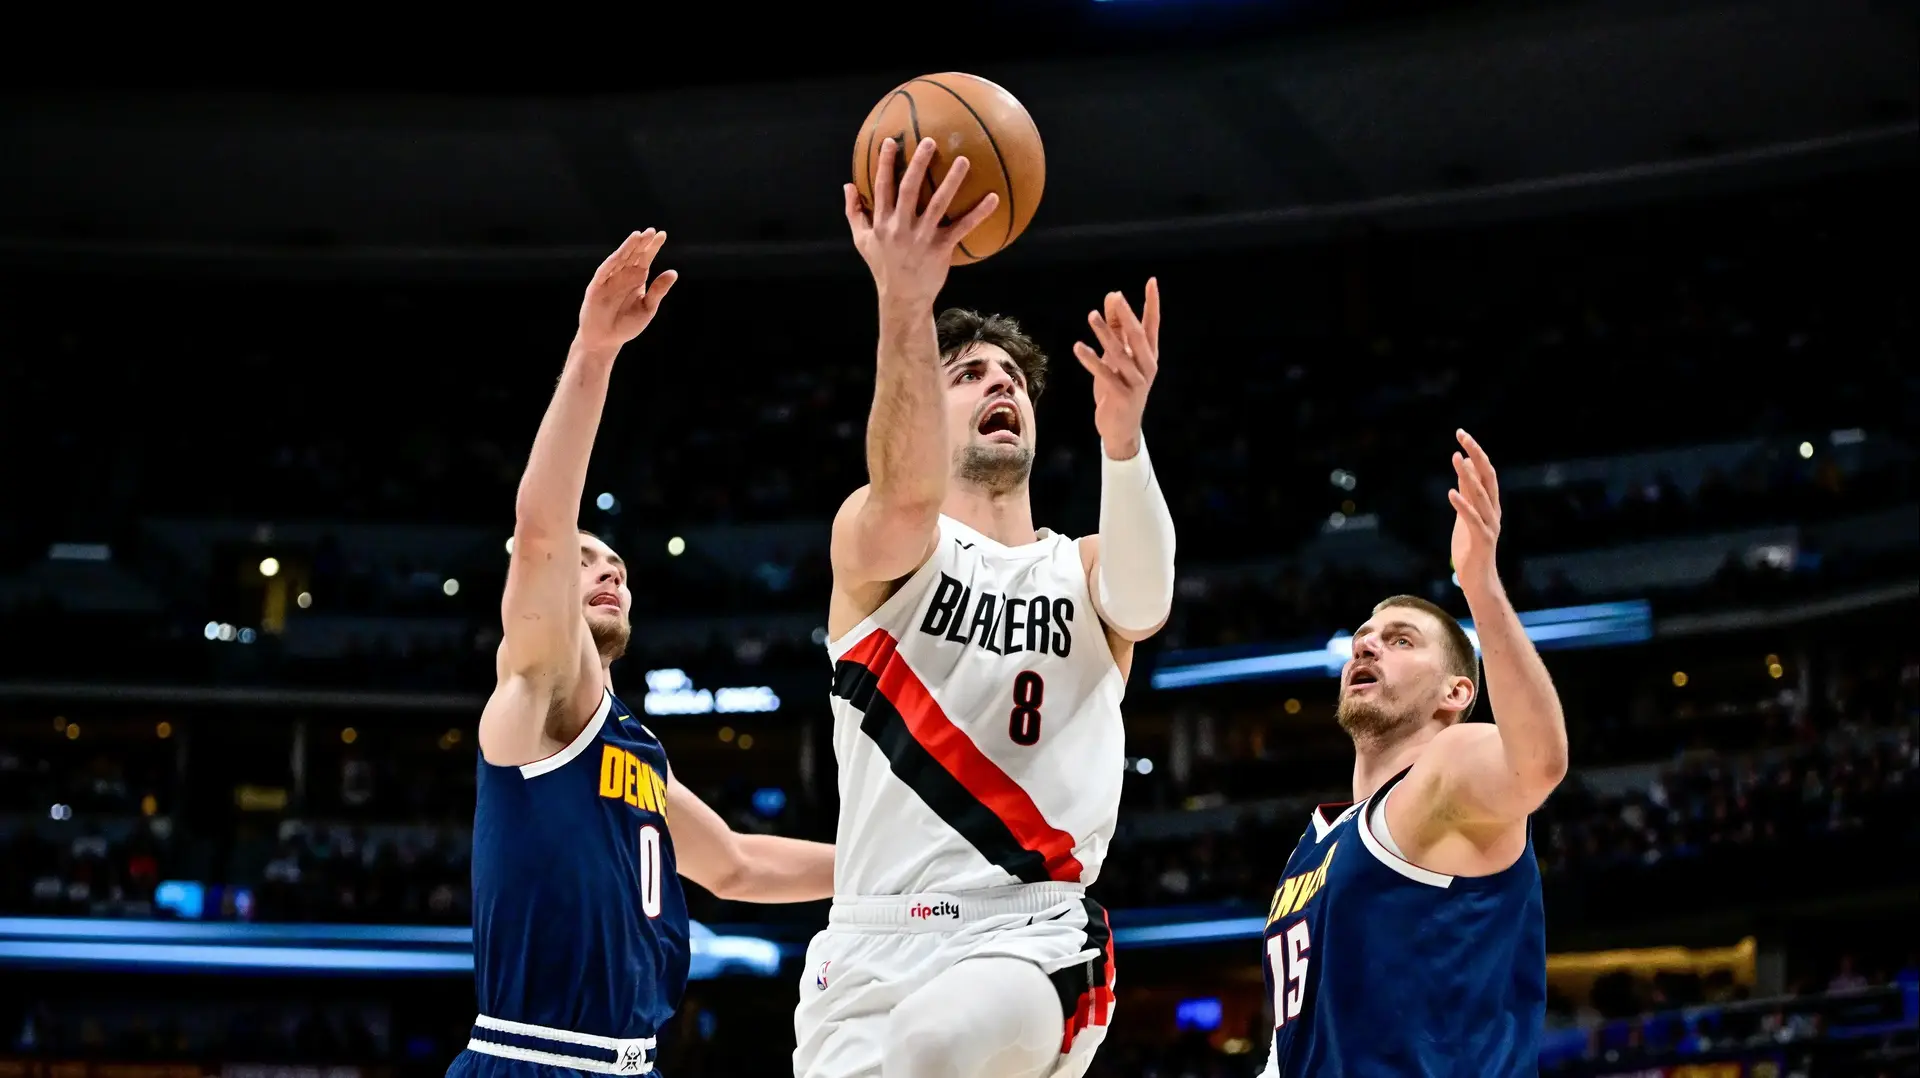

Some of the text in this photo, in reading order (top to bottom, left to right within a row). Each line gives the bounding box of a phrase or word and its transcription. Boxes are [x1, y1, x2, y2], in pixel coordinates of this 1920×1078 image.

[1009, 669, 1044, 746] 8
[599, 744, 668, 827] DENVE
[639, 824, 662, 920] 0
[910, 901, 960, 920] ripcity
[1266, 917, 1312, 1030] 15
